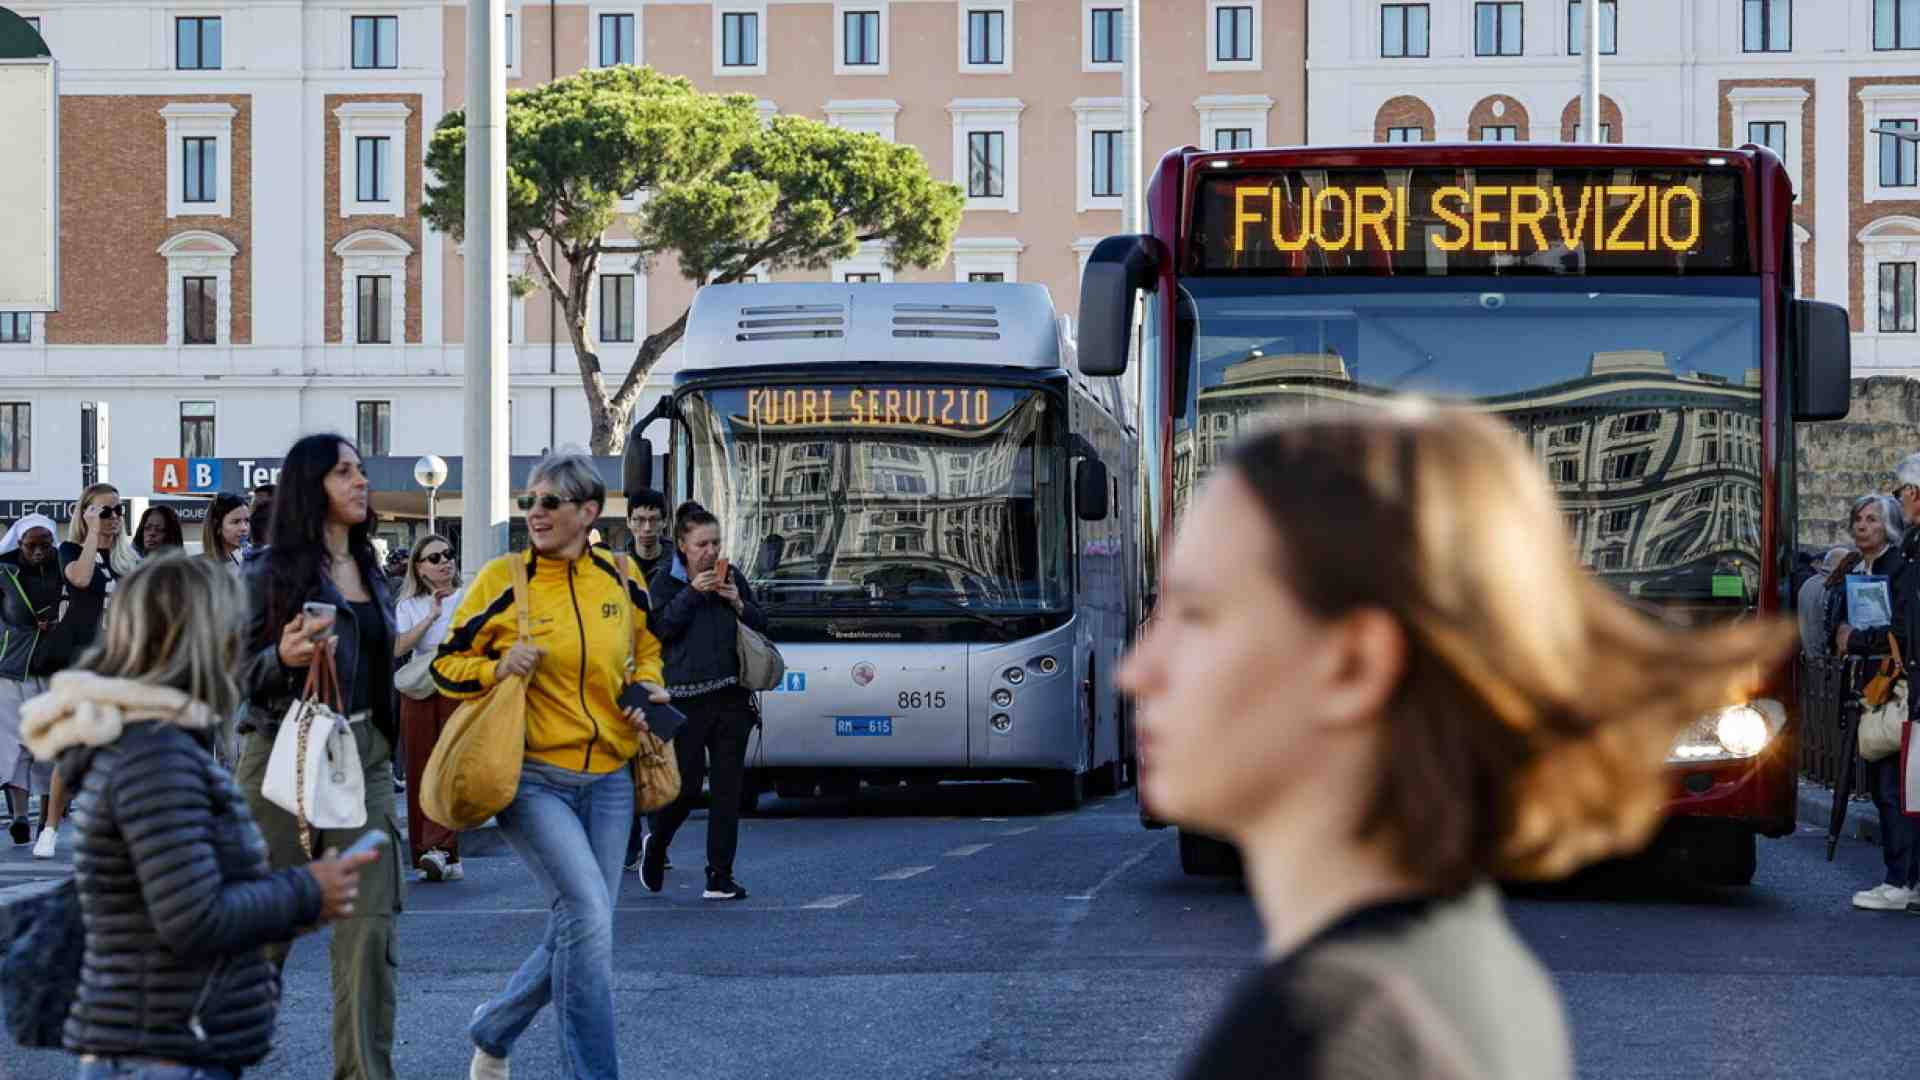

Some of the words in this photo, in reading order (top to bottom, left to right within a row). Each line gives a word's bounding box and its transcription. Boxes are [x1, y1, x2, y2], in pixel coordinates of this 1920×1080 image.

[1234, 186, 1405, 252] FUORI
[1431, 185, 1700, 252] SERVIZIO
[748, 388, 832, 425] FUORI
[850, 388, 988, 426] SERVIZIO
[161, 463, 179, 488] A
[196, 463, 212, 488] B
[238, 460, 281, 489] Ter
[898, 691, 946, 709] 8615
[838, 720, 852, 733] RM
[869, 720, 890, 733] 615
